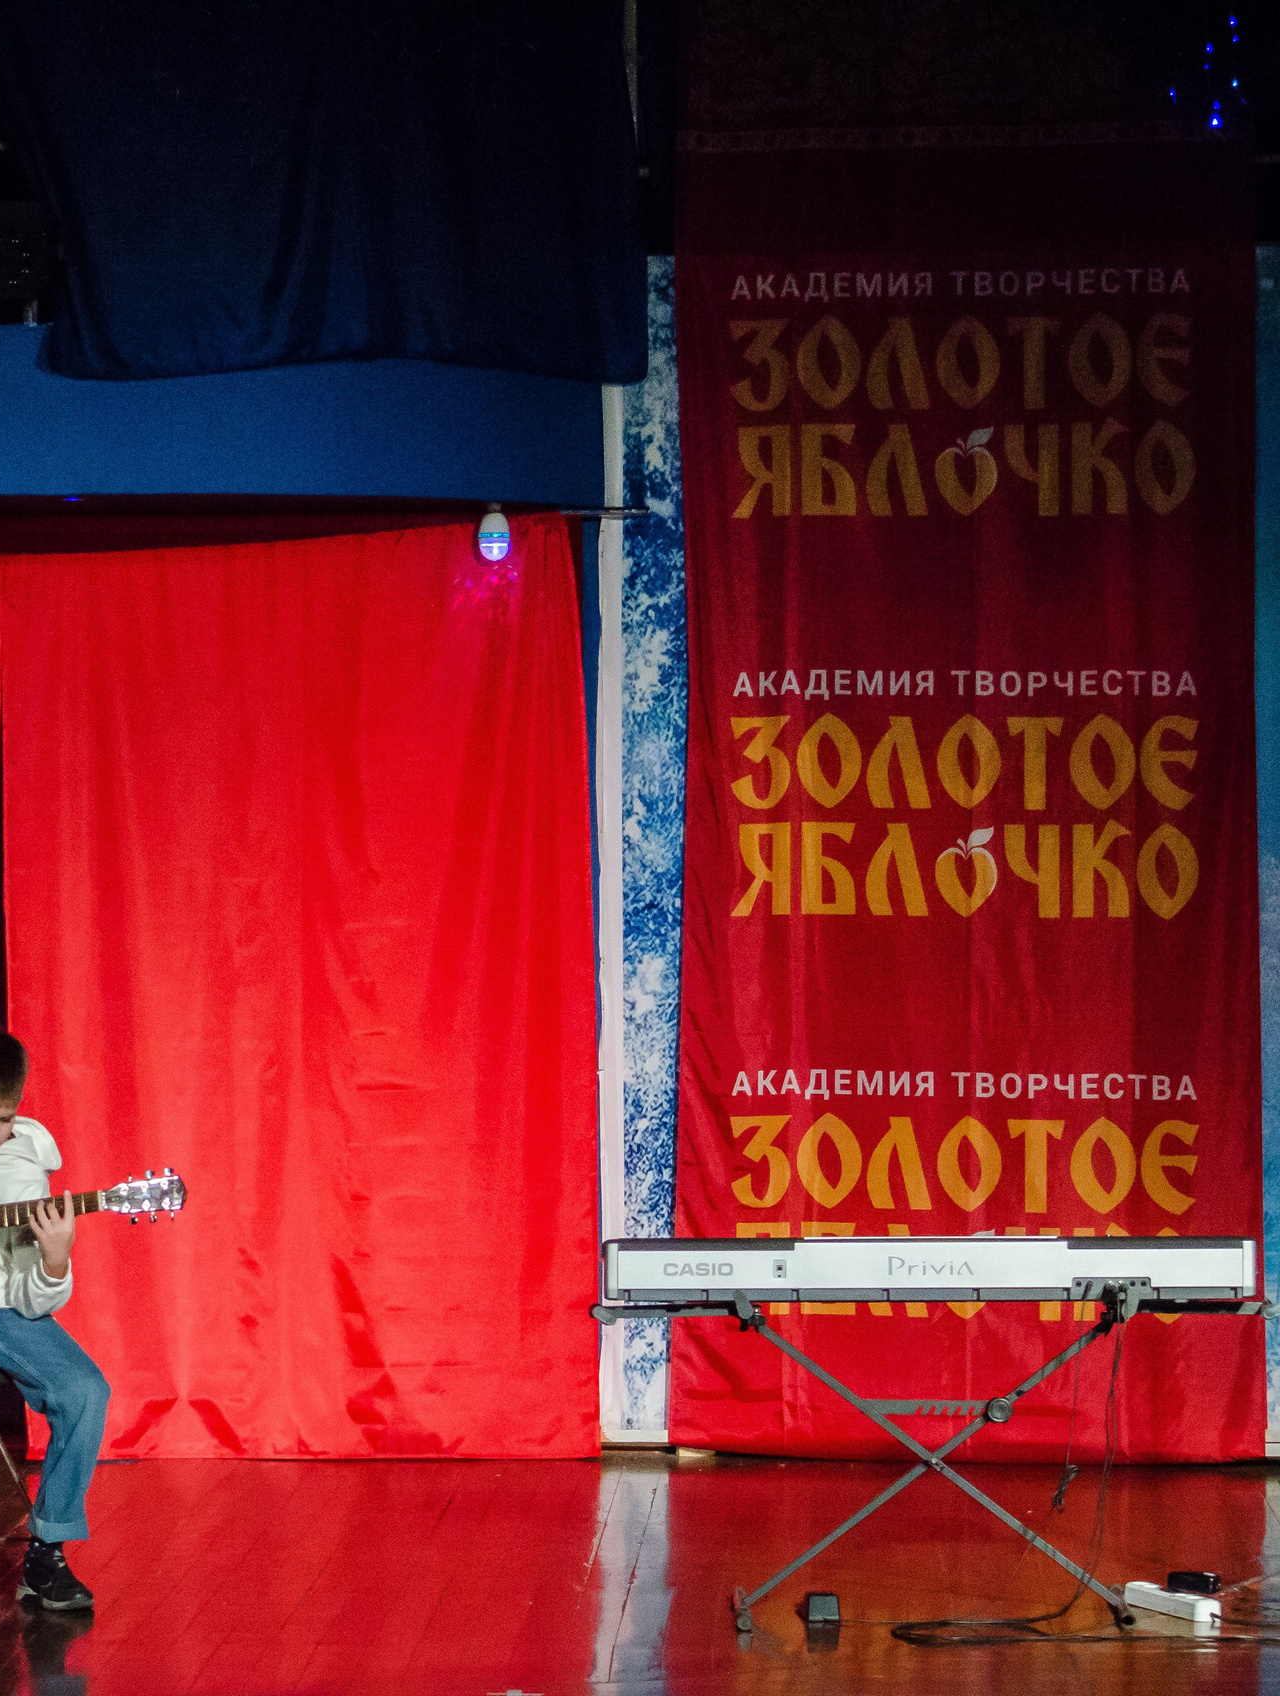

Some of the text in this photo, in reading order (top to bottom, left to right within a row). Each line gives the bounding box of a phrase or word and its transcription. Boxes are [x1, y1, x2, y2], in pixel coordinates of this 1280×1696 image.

[730, 268, 1192, 301] АКАДЕМИЯ ТВОРЧЕСТВА
[731, 416, 1196, 519] ЯБЛОЧКО
[732, 669, 1199, 701] АКАДЕМИЯ ТВОРЧЕСТВА
[730, 818, 1200, 921] ЯБЛОЧКО
[731, 1069, 1198, 1101] АКАДЕМИЯ ТВОРЧЕСТВА
[663, 1262, 734, 1277] CASIO
